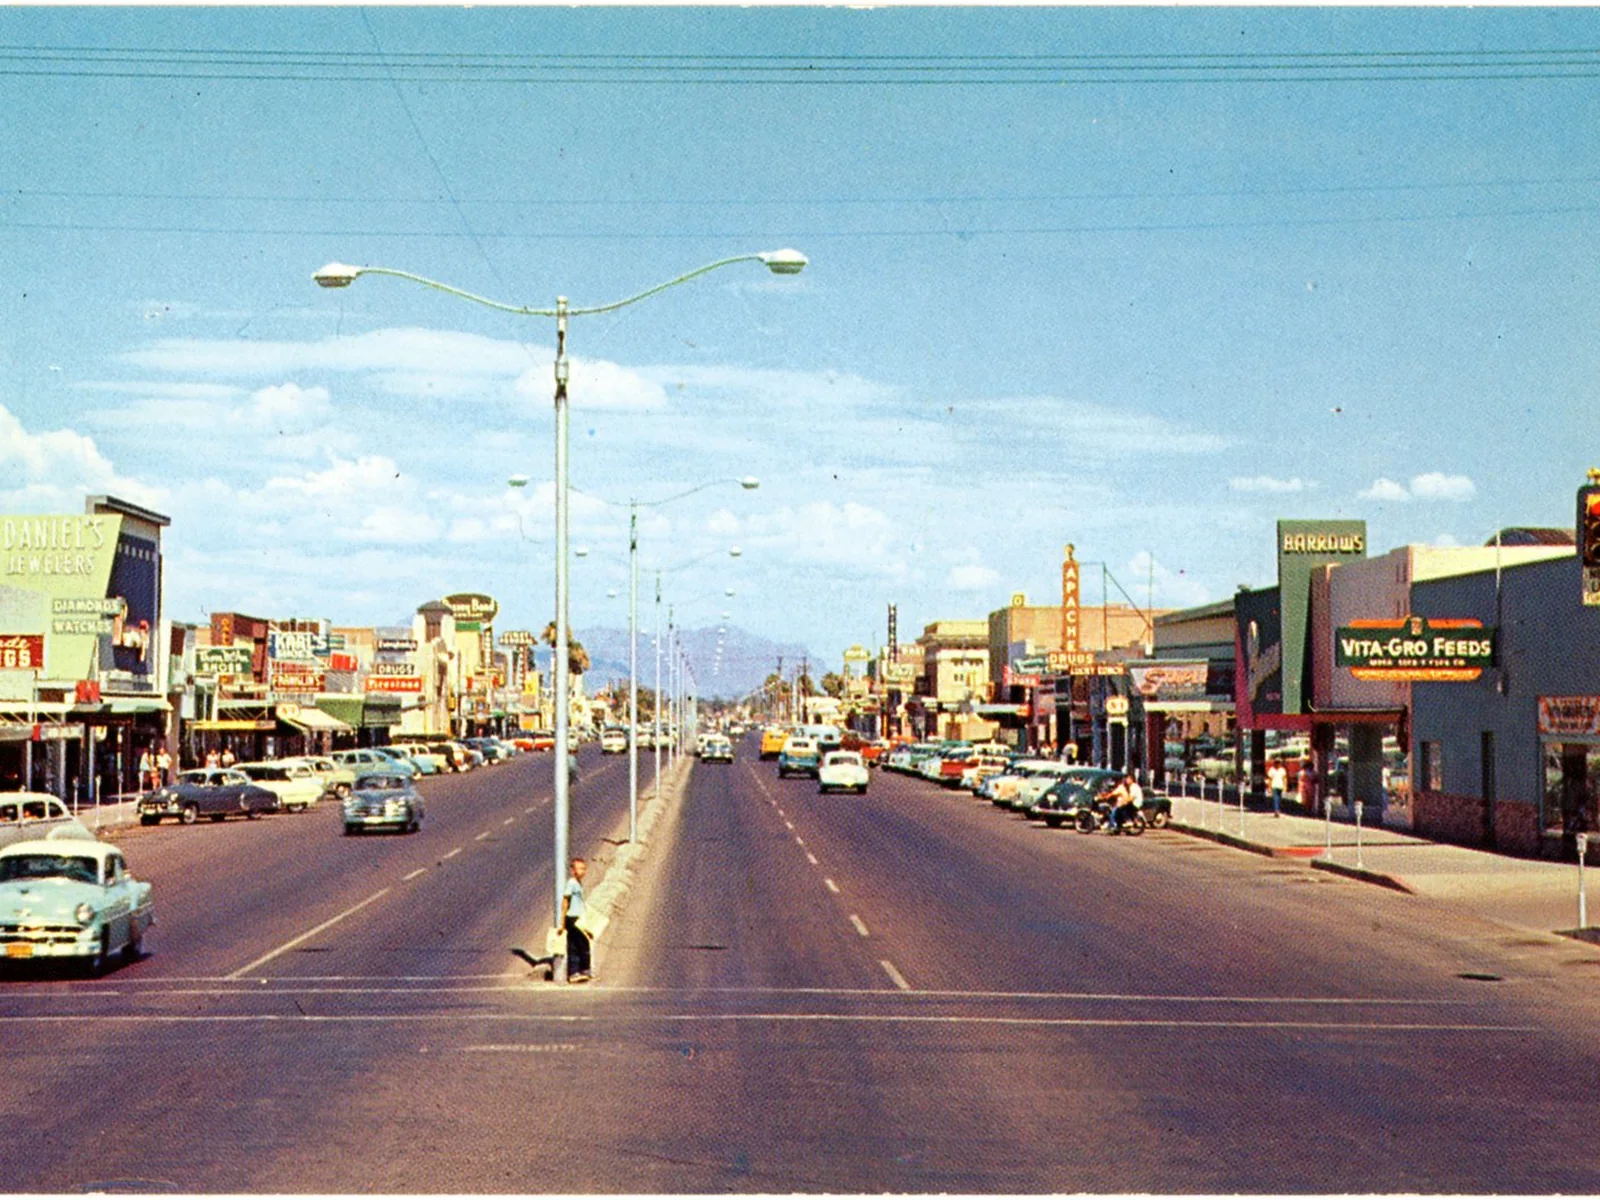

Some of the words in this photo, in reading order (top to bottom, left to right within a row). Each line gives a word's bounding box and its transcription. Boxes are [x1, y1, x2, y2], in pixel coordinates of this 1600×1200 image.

[4, 518, 105, 550] DANIEL'S
[1283, 534, 1364, 554] BARROWS
[7, 554, 96, 576] JEWELERS
[53, 600, 118, 613] DIAMONDS
[1065, 566, 1077, 651] APACHE
[53, 620, 111, 634] WATCHES
[0, 636, 31, 650] de
[1341, 637, 1428, 657] VITA-GRO
[1433, 637, 1491, 657] FEEDS
[0, 649, 31, 668] GS
[1049, 653, 1095, 665] DRUGS
[379, 664, 413, 675] DRUGS
